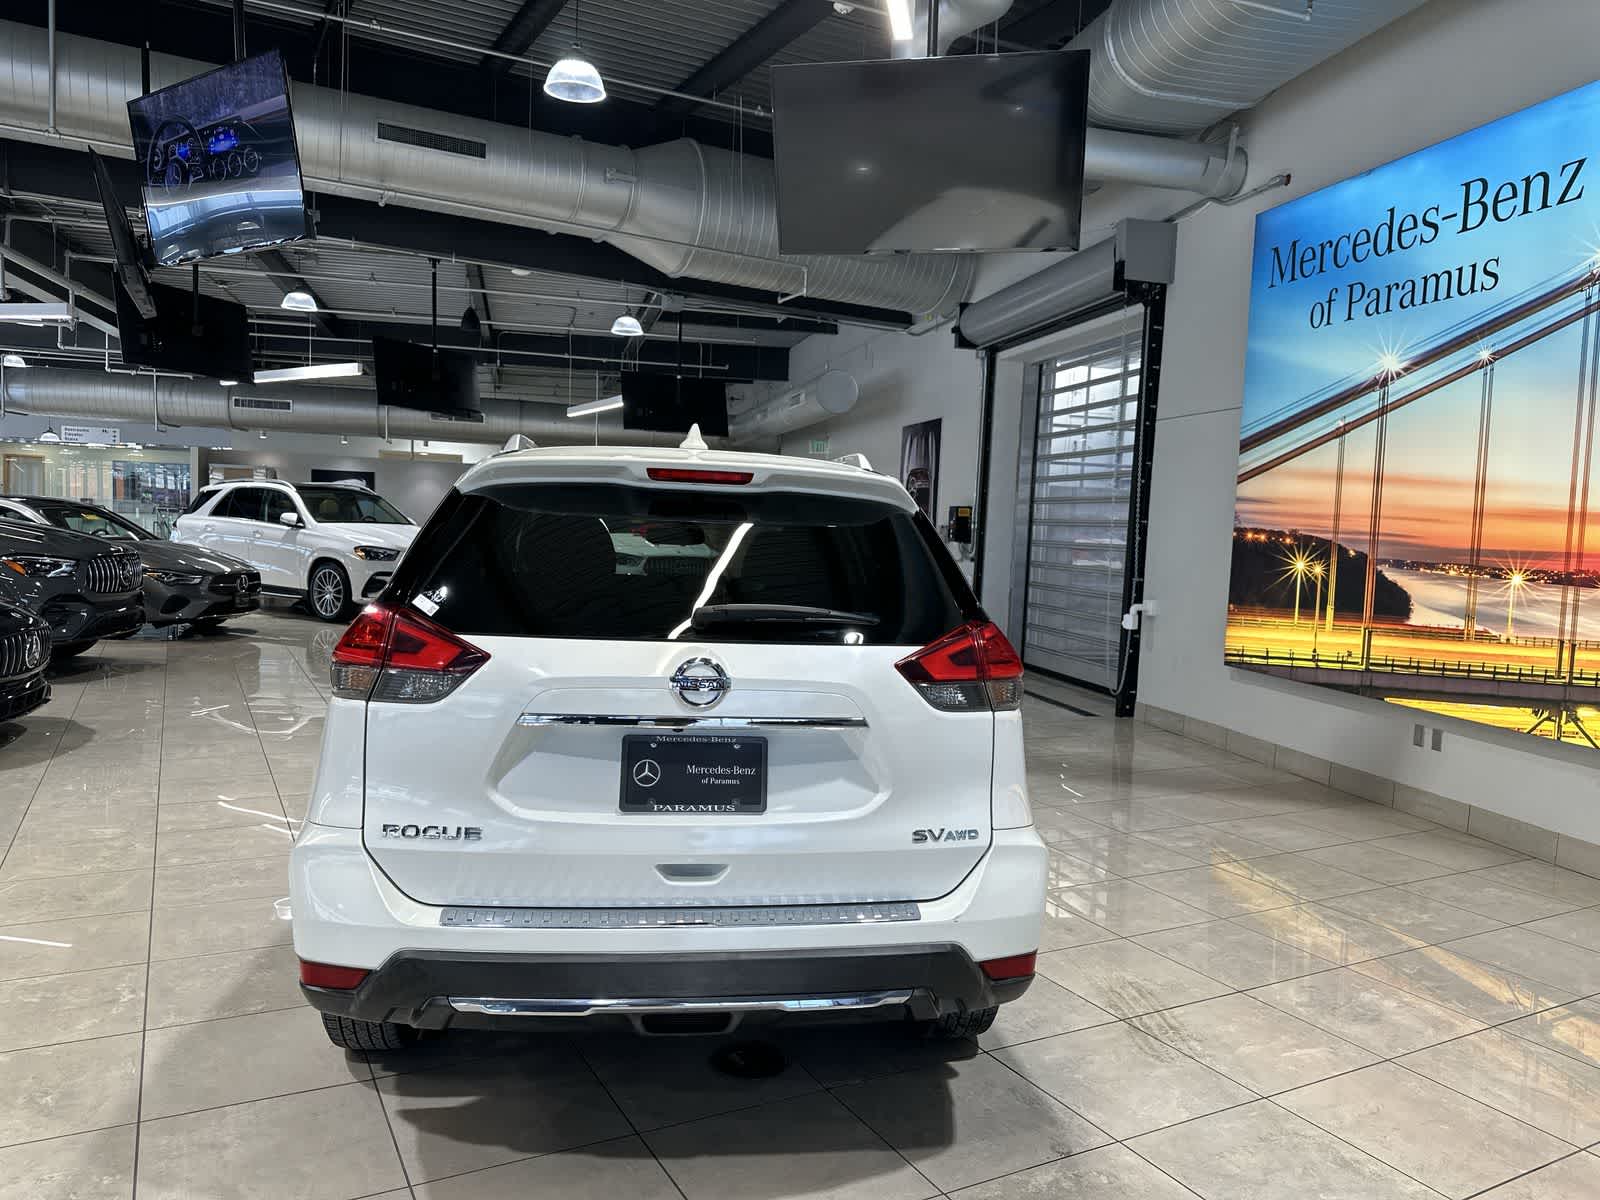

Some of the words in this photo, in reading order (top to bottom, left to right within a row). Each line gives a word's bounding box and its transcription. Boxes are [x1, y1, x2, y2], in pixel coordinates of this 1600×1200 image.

[1268, 157, 1588, 289] Mercedes-Benz
[1309, 287, 1338, 329] of
[1343, 256, 1500, 322] Paramus
[675, 679, 725, 689] NISSAN
[656, 735, 737, 743] Mercedes-Benz
[686, 764, 756, 776] Mercedes-Benz
[701, 777, 709, 785] of
[653, 804, 736, 812] PARAMUS
[381, 823, 483, 841] ROGUE
[911, 827, 945, 844] SV
[943, 828, 979, 842] AWD
